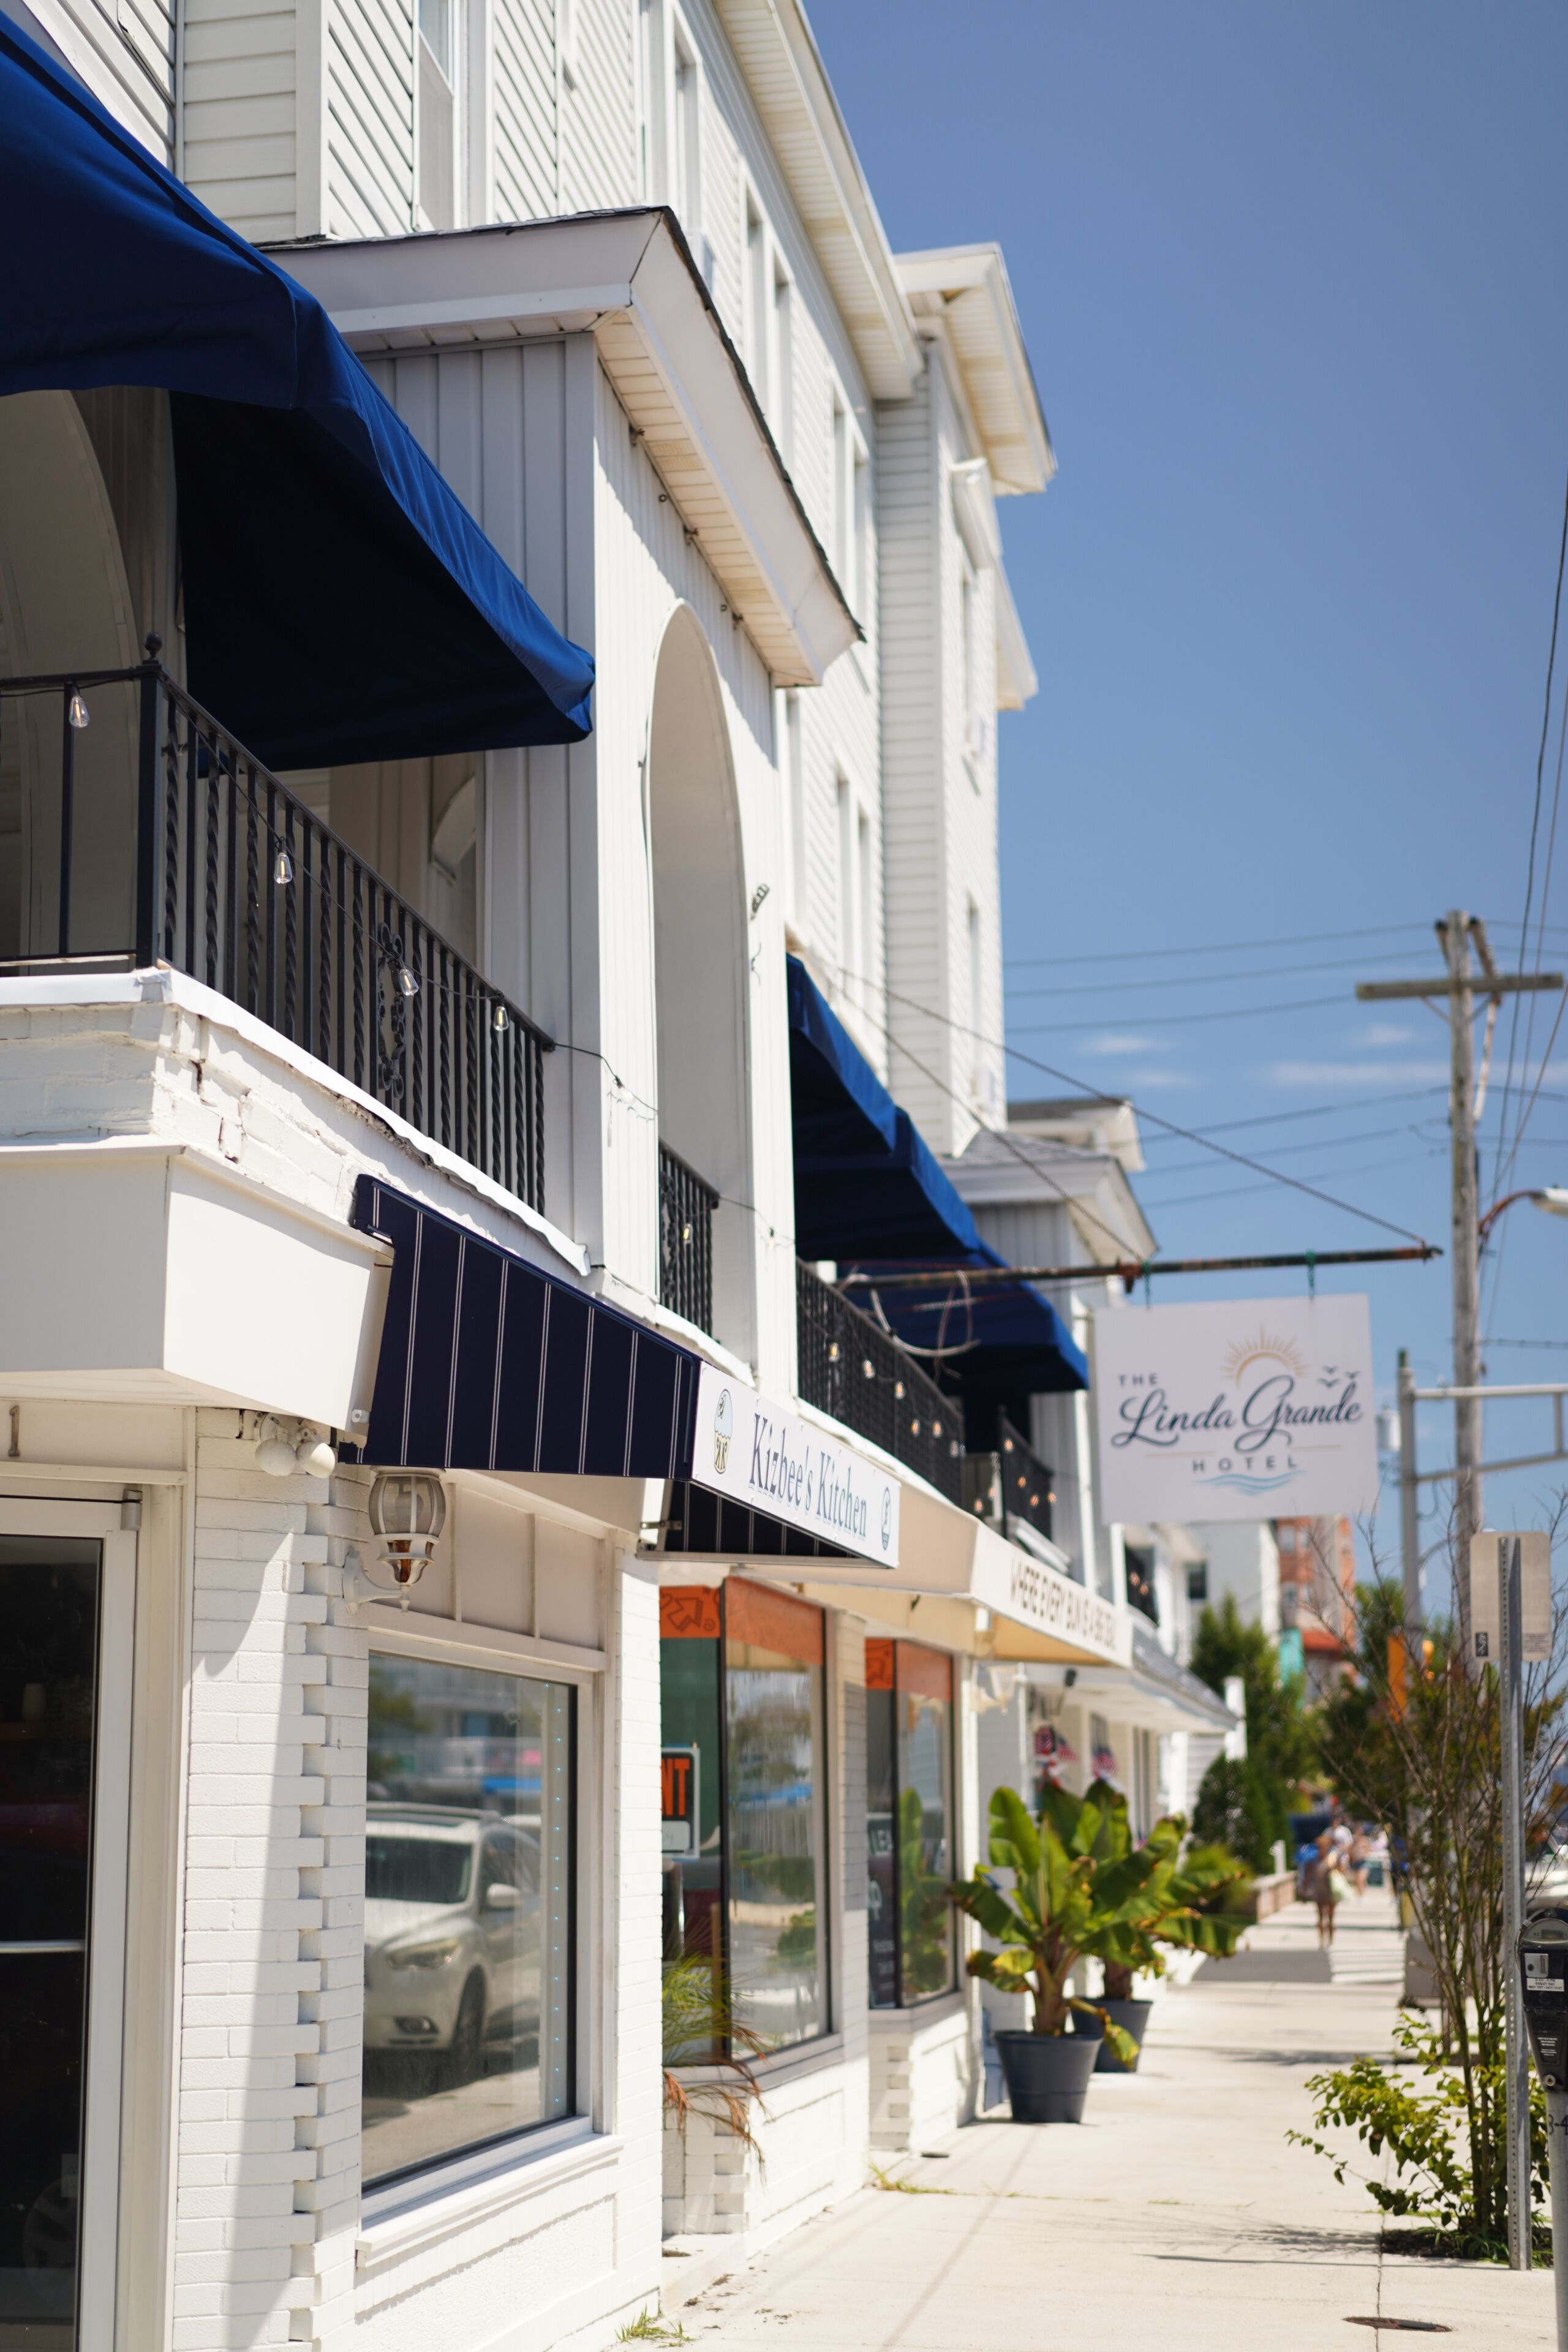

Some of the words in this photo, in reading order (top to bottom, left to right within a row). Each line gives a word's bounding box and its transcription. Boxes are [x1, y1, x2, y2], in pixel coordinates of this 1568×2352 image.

[1118, 1373, 1159, 1387] THE
[1110, 1389, 1236, 1449] Linda
[1234, 1375, 1363, 1453] Grande
[748, 1412, 813, 1513] Kizbee's
[816, 1450, 867, 1540] Kitchen
[1193, 1456, 1298, 1472] HOTEL
[1011, 1558, 1039, 1613] WHERE
[1039, 1574, 1065, 1625] EVERY
[662, 1757, 691, 1817] NT
